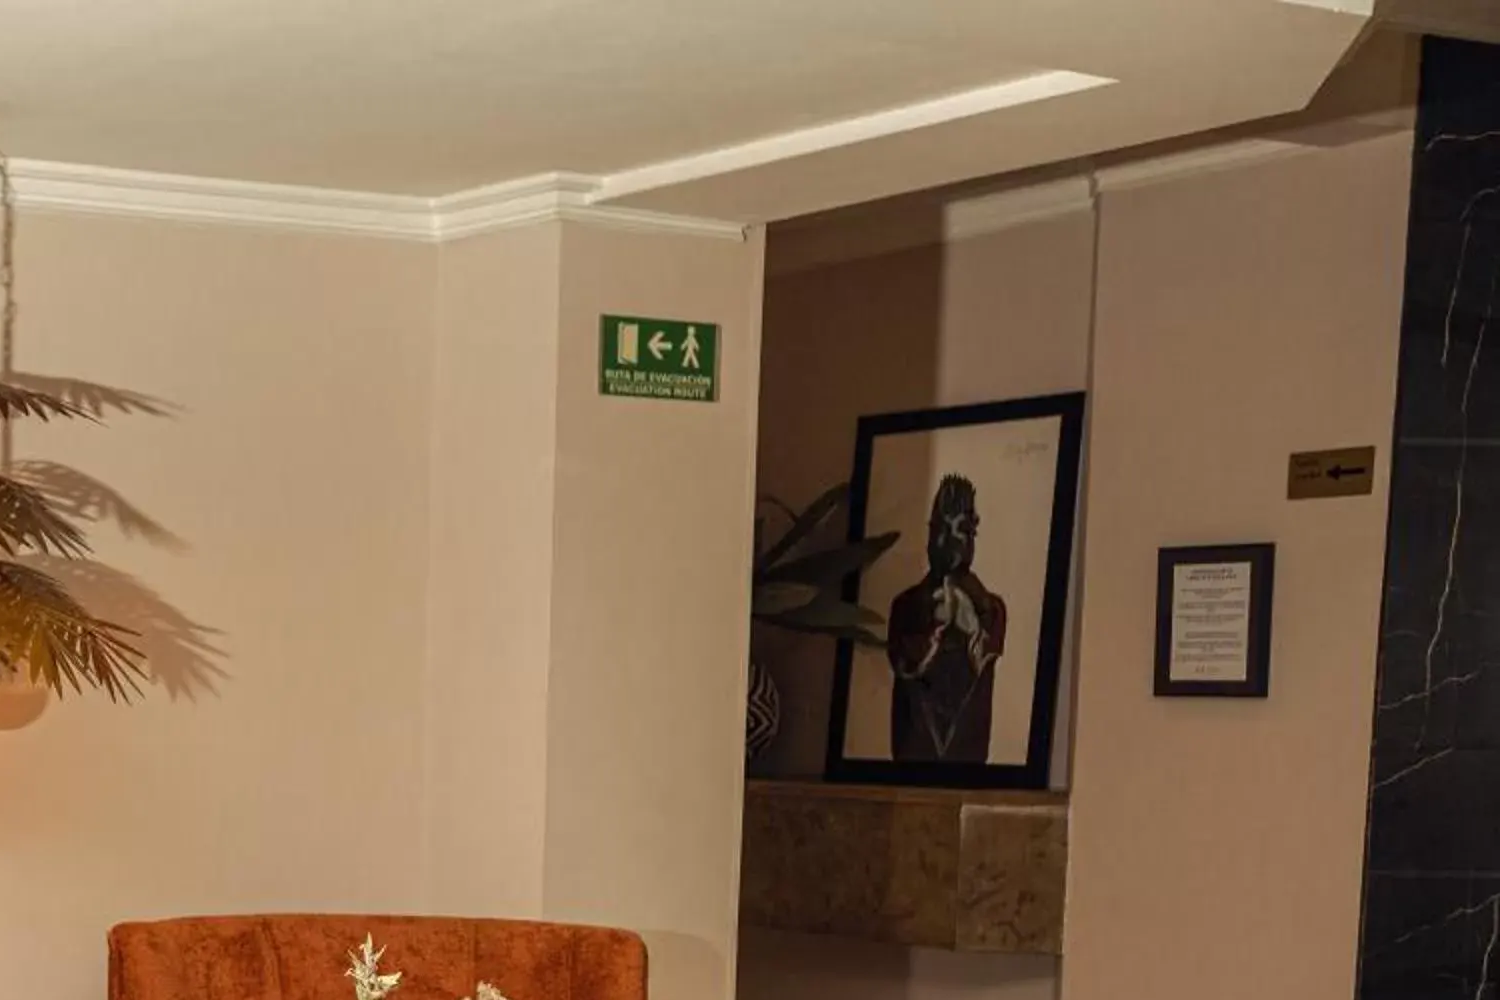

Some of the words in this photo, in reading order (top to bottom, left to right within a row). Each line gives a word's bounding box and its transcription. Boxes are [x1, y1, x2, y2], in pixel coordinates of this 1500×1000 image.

[605, 369, 631, 381] RUTA
[634, 371, 647, 382] DE
[609, 384, 671, 396] EVACUATION
[673, 387, 706, 398] ROUTE
